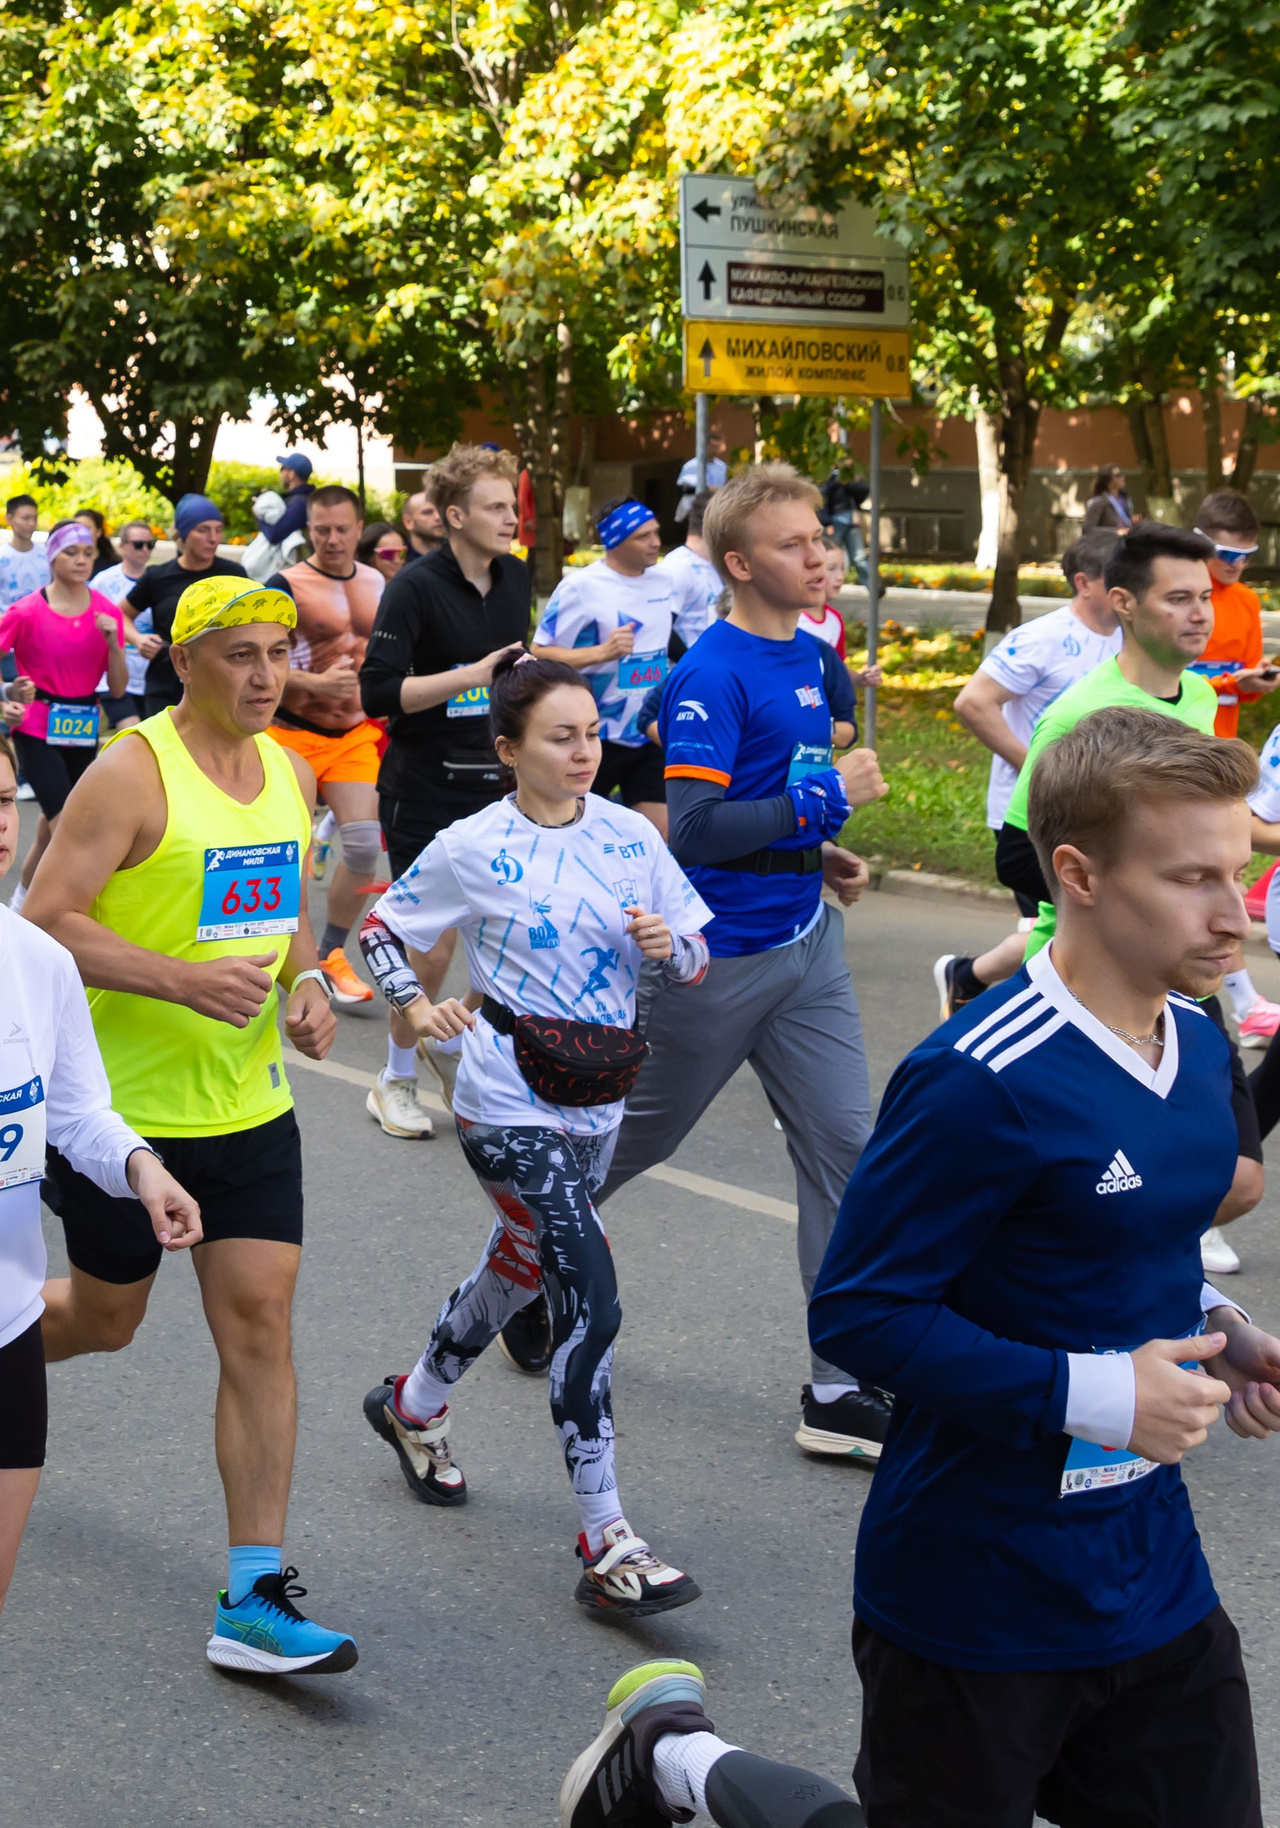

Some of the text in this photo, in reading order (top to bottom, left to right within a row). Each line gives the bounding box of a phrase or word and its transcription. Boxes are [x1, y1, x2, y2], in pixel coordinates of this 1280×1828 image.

[730, 215, 839, 240] ПУШКИНСКАЯ
[726, 335, 881, 363] МИХАЙЛОВСКИЙ
[798, 364, 866, 382] комплекс
[675, 711, 695, 721] ANTA
[53, 718, 93, 735] 1024
[225, 845, 282, 859] ДИНАМОВСКАЯ
[242, 856, 265, 866] МИЛЯ
[221, 876, 282, 916] 633
[1095, 1173, 1143, 1195] adidas
